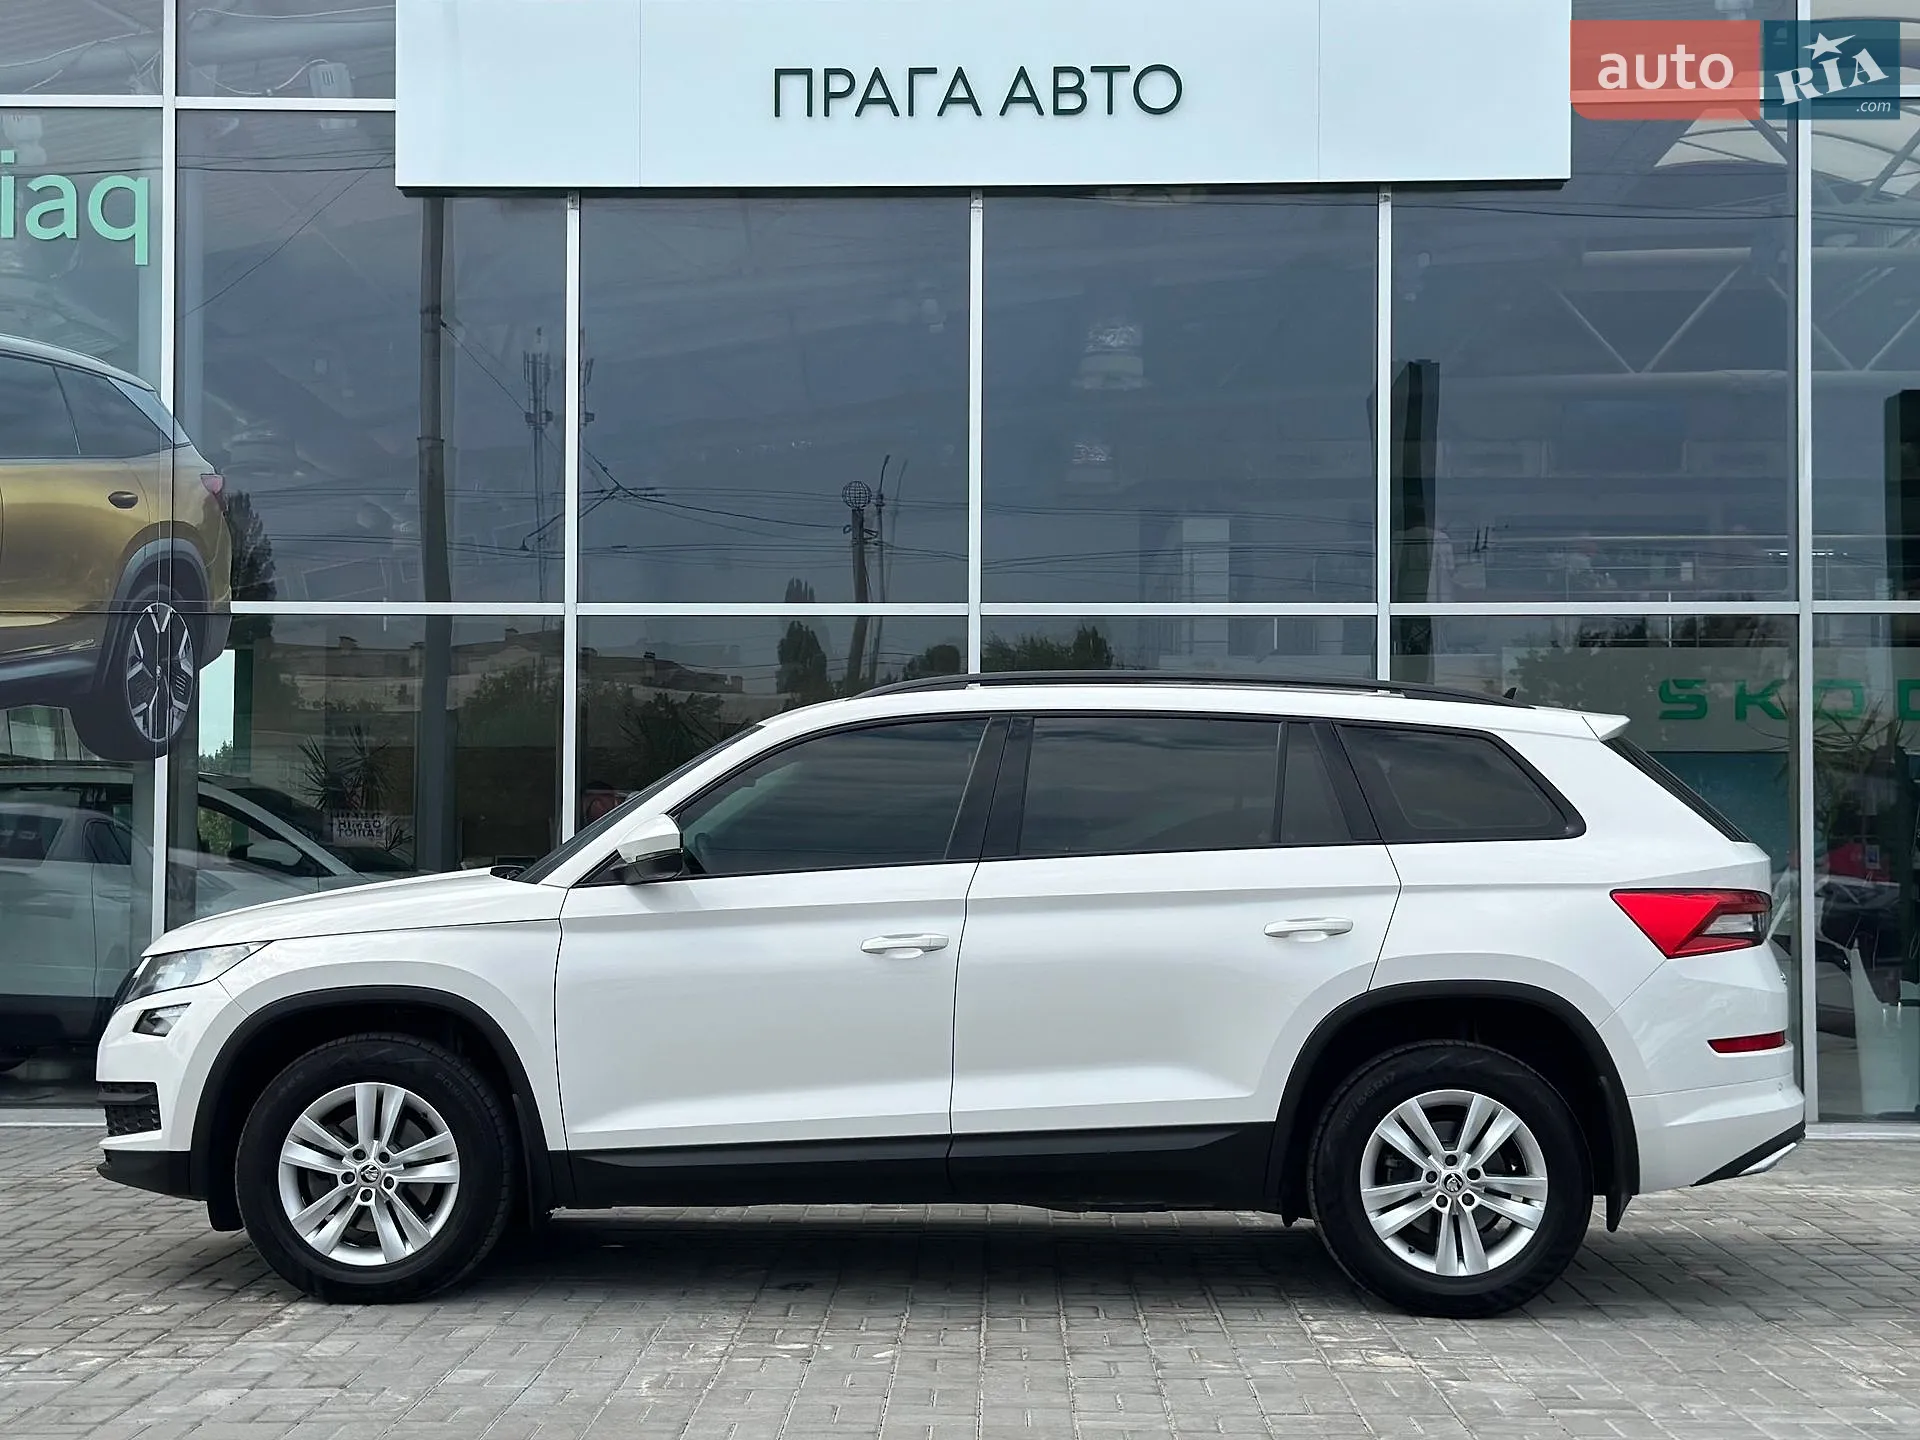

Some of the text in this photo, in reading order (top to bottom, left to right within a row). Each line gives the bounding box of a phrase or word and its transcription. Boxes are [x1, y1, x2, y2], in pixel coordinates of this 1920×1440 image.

[774, 64, 1183, 117] ПРАГА АВТО
[0, 149, 149, 266] iaq
